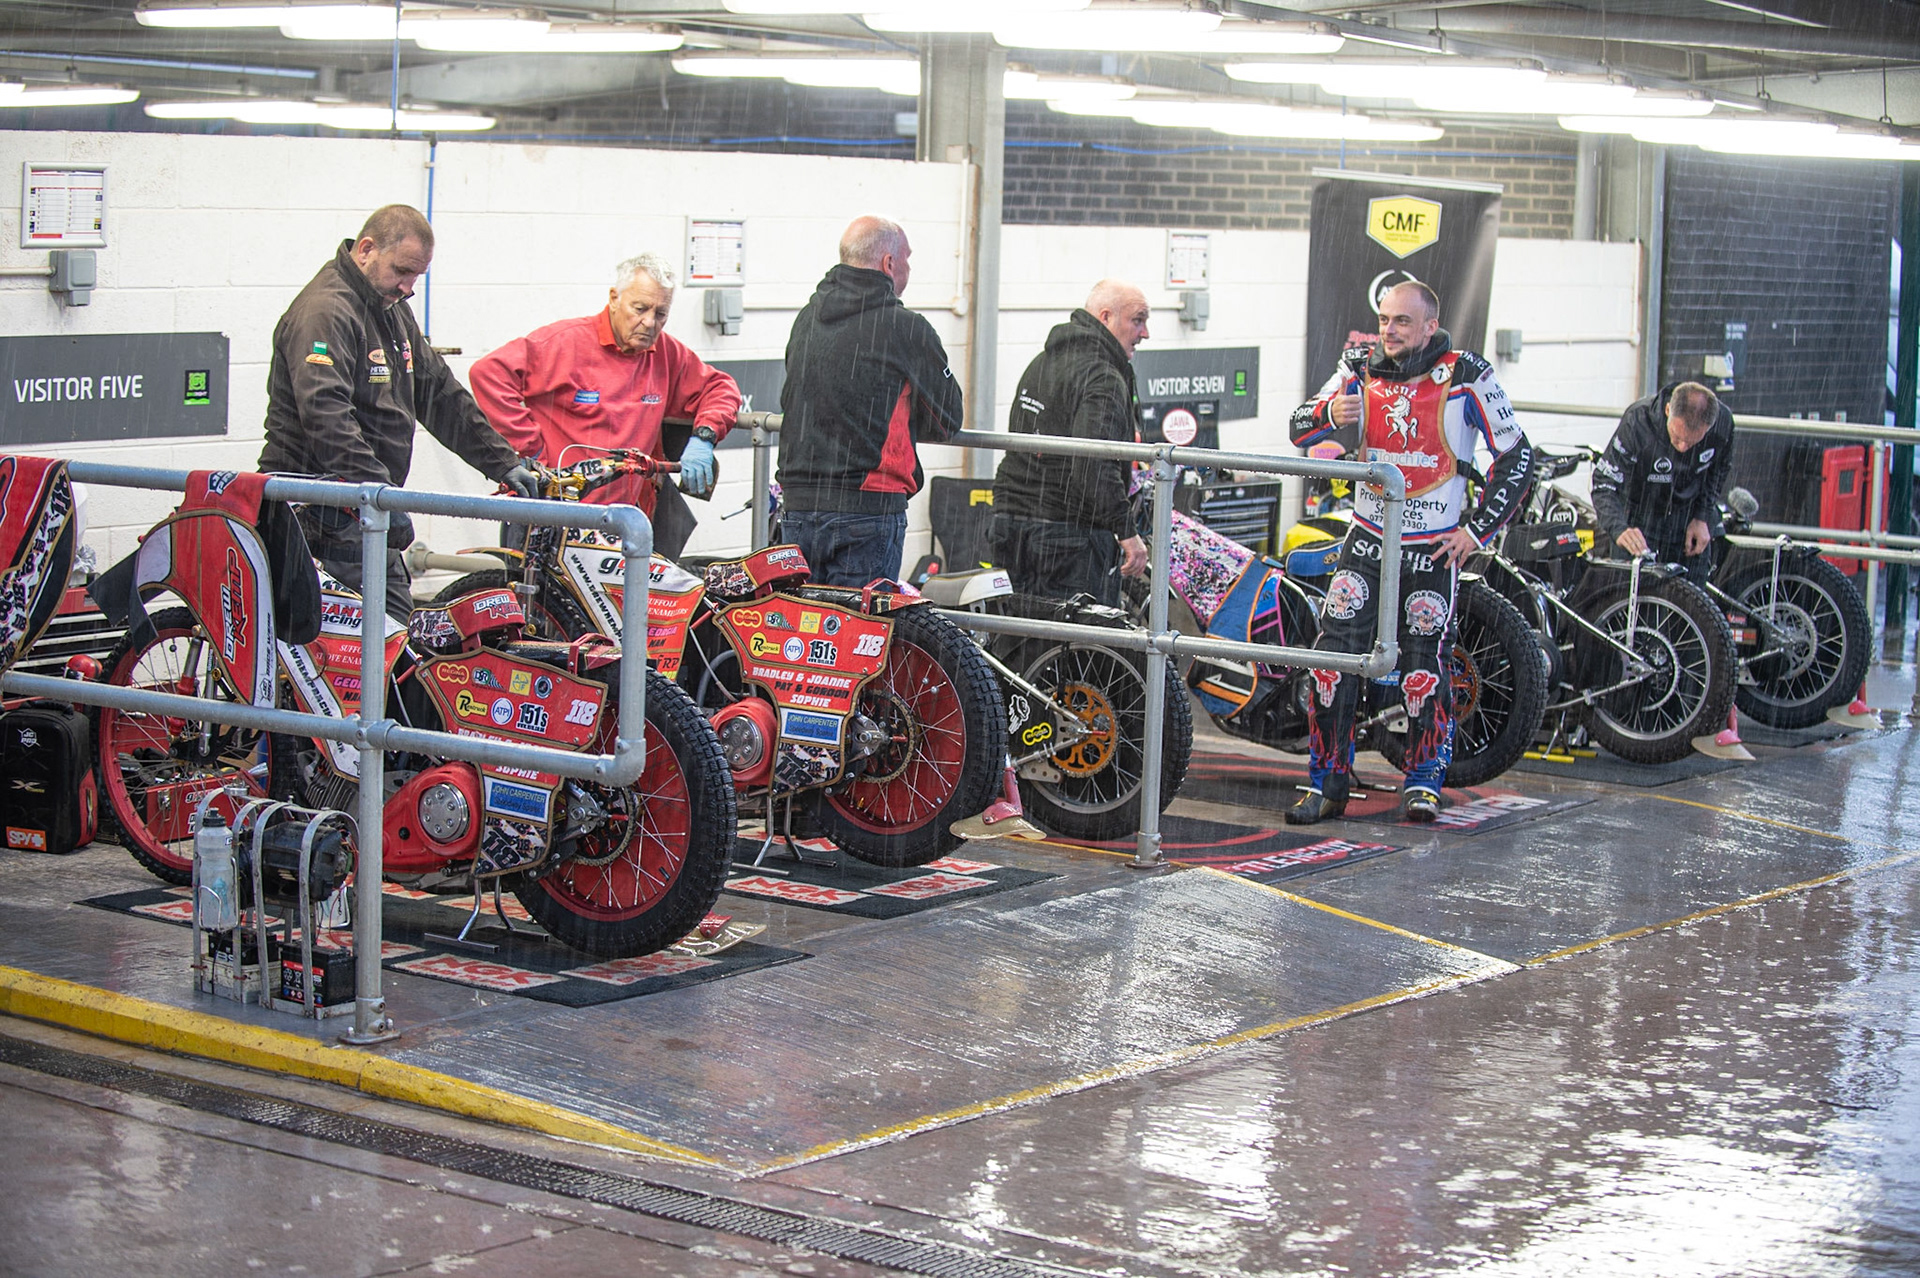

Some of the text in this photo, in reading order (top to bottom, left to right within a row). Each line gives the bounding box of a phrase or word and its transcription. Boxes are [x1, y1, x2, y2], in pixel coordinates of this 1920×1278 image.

[1382, 211, 1427, 233] CMF
[1438, 368, 1445, 381] 7
[14, 375, 144, 403] VISITOR FIVE
[1148, 377, 1190, 396] VISITOR
[1192, 376, 1226, 394] SEVEN
[1384, 385, 1418, 399] Kent
[1169, 415, 1190, 429] JAWA
[1378, 450, 1438, 467] TouchTec
[1471, 448, 1531, 532] R.I.P Nan
[767, 549, 799, 565] DREW
[227, 547, 248, 648] KEMP
[473, 594, 511, 614] DREW
[1427, 591, 1448, 614] BUSTERS
[221, 583, 235, 664] DREW
[321, 613, 362, 629] acing
[1335, 611, 1354, 619] CLUB
[852, 634, 885, 658] 118
[474, 670, 488, 682] DSR
[752, 666, 852, 689] BRADLEY & JOANNE
[774, 681, 850, 699] PAT & GORDON
[790, 694, 832, 708] SOPHIE
[494, 706, 510, 717] ATPI
[564, 699, 598, 728] 118
[789, 714, 838, 728] JOHN CARPENTER
[492, 785, 546, 804] JOHN CARPENTER
[9, 830, 32, 846] SPY
[747, 877, 858, 901] NGK
[422, 956, 554, 985] NGK
